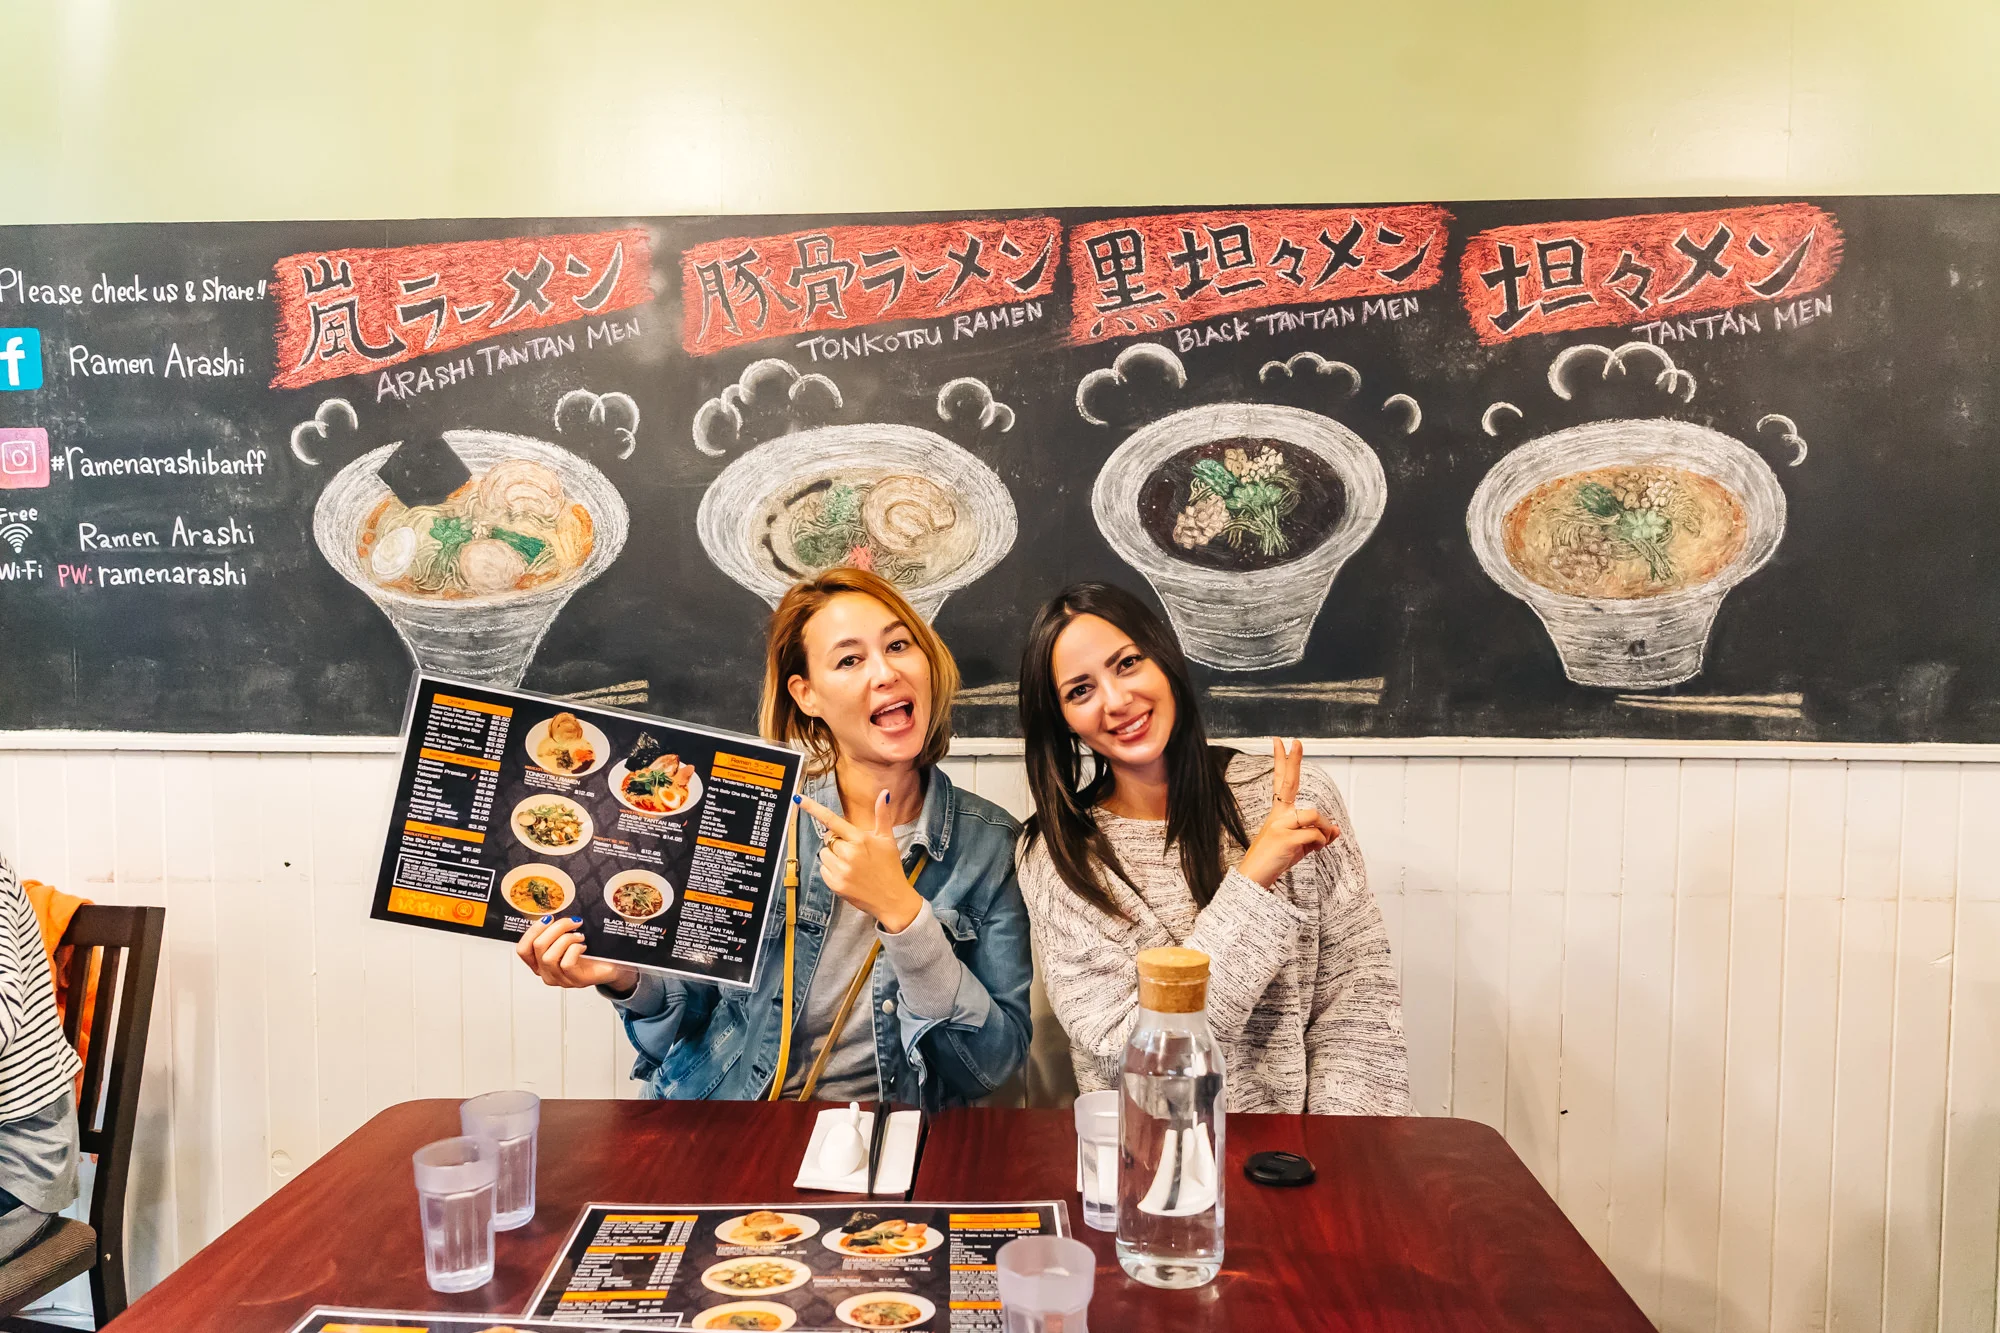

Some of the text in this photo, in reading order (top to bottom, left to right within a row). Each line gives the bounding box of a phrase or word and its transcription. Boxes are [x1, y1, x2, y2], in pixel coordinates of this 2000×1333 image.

[0, 267, 83, 305] Please
[92, 272, 148, 304] check
[153, 283, 179, 303] us
[185, 280, 197, 303] &
[693, 231, 1055, 343] 豚骨ラーメン
[1479, 221, 1818, 334] 坦々メン
[290, 241, 623, 375] 嵐ラーメン
[1175, 296, 1420, 353] BLACK TANTAN MEN
[1631, 294, 1834, 345] TANTAN MEN
[796, 302, 1043, 362] TONKOTSU RAMEN
[69, 342, 245, 378] Ramen Arashi
[375, 317, 642, 404] ARASHI TANTAN MEN
[50, 446, 267, 480] #ramenarashibanff
[0, 508, 38, 525] Free
[78, 515, 255, 552] Ramen Arashi
[0, 560, 43, 581] Wi-Fi
[57, 561, 247, 588] PW: ramenarashi
[558, 776, 580, 785] RAMEN
[643, 817, 667, 826] TANTAN
[692, 859, 720, 869] SEAFOOD
[720, 864, 741, 873] RAMEN
[695, 844, 716, 853] SHOYU
[716, 849, 737, 857] RAMEN
[704, 877, 725, 885] RAMEN
[603, 917, 623, 926] BLACK
[624, 921, 648, 930] TANTAN
[707, 945, 728, 953] RAMEN
